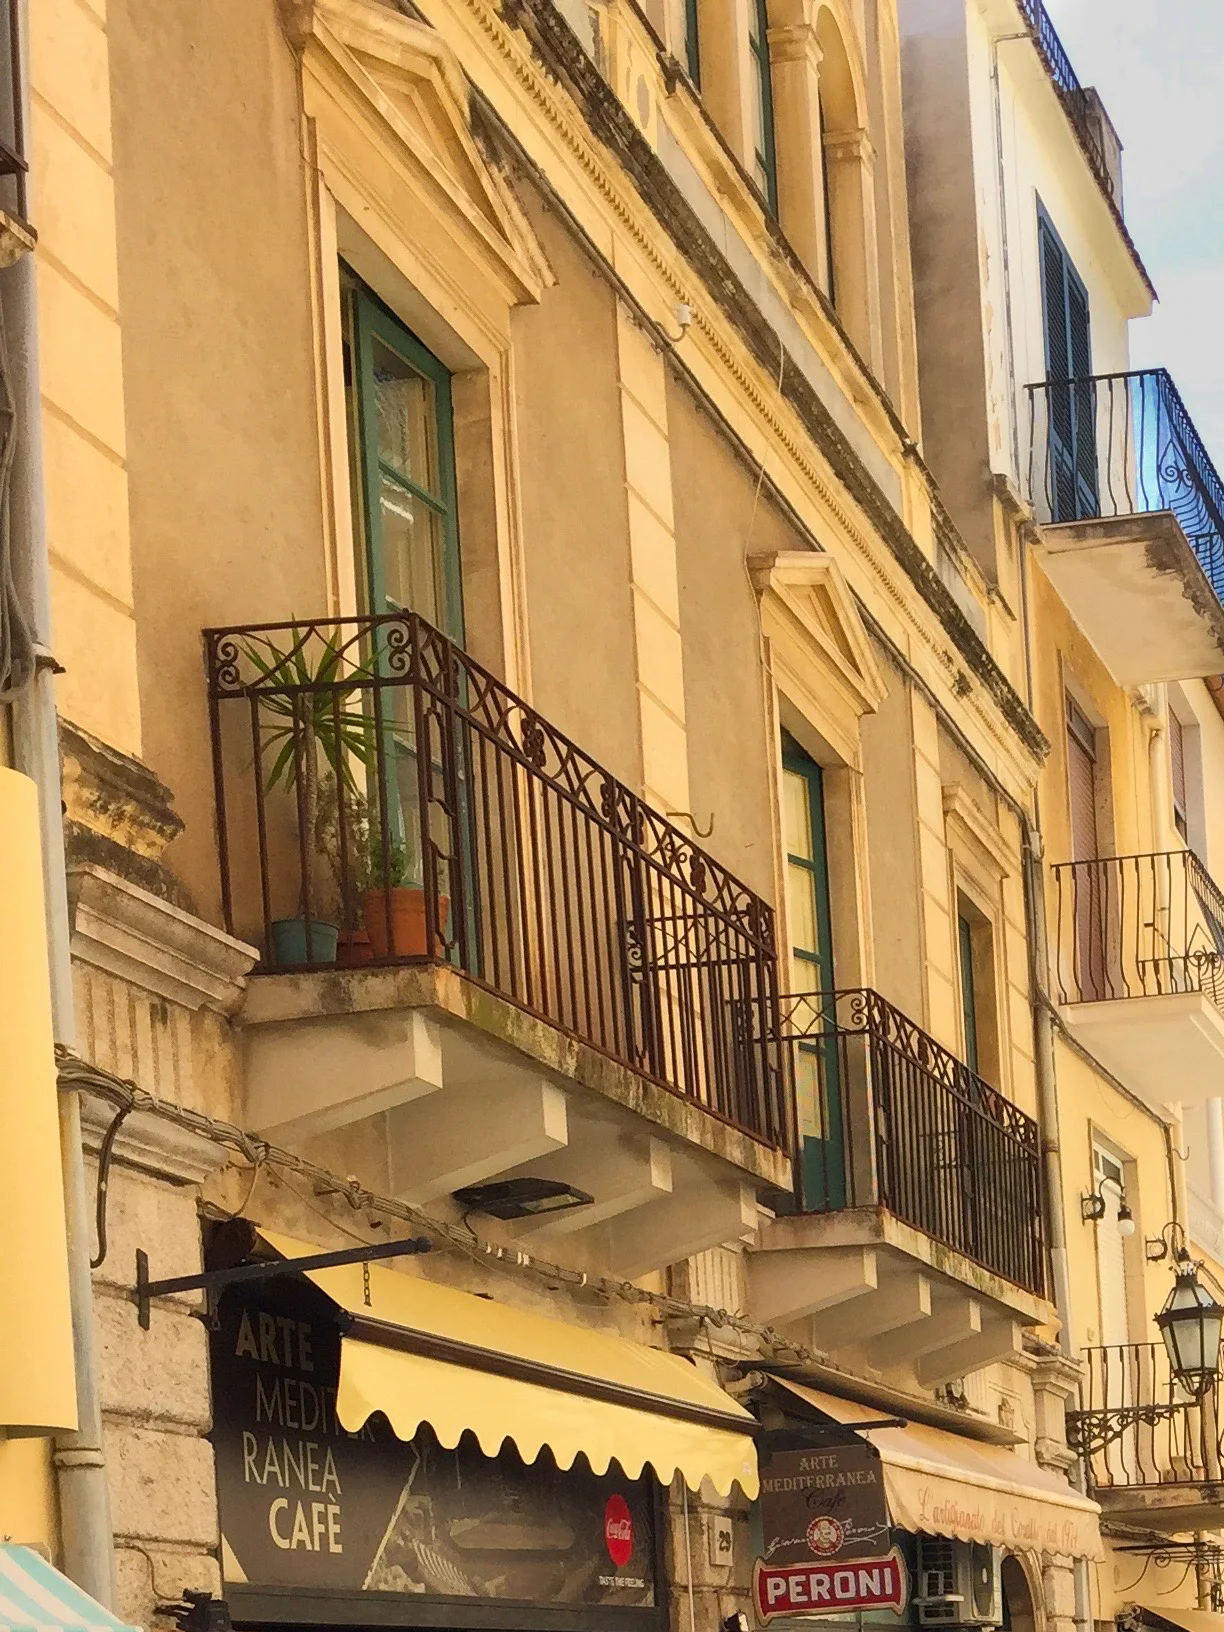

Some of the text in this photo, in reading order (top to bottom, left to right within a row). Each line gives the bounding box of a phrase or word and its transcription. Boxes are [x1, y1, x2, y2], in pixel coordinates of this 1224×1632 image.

[235, 1308, 314, 1372] ARTE
[242, 1430, 342, 1495] RANEA
[762, 1470, 878, 1493] MEDITERRANEA
[799, 1454, 838, 1471] ARTE
[269, 1493, 342, 1553] CAFÈ
[766, 1567, 893, 1605] PERONI
